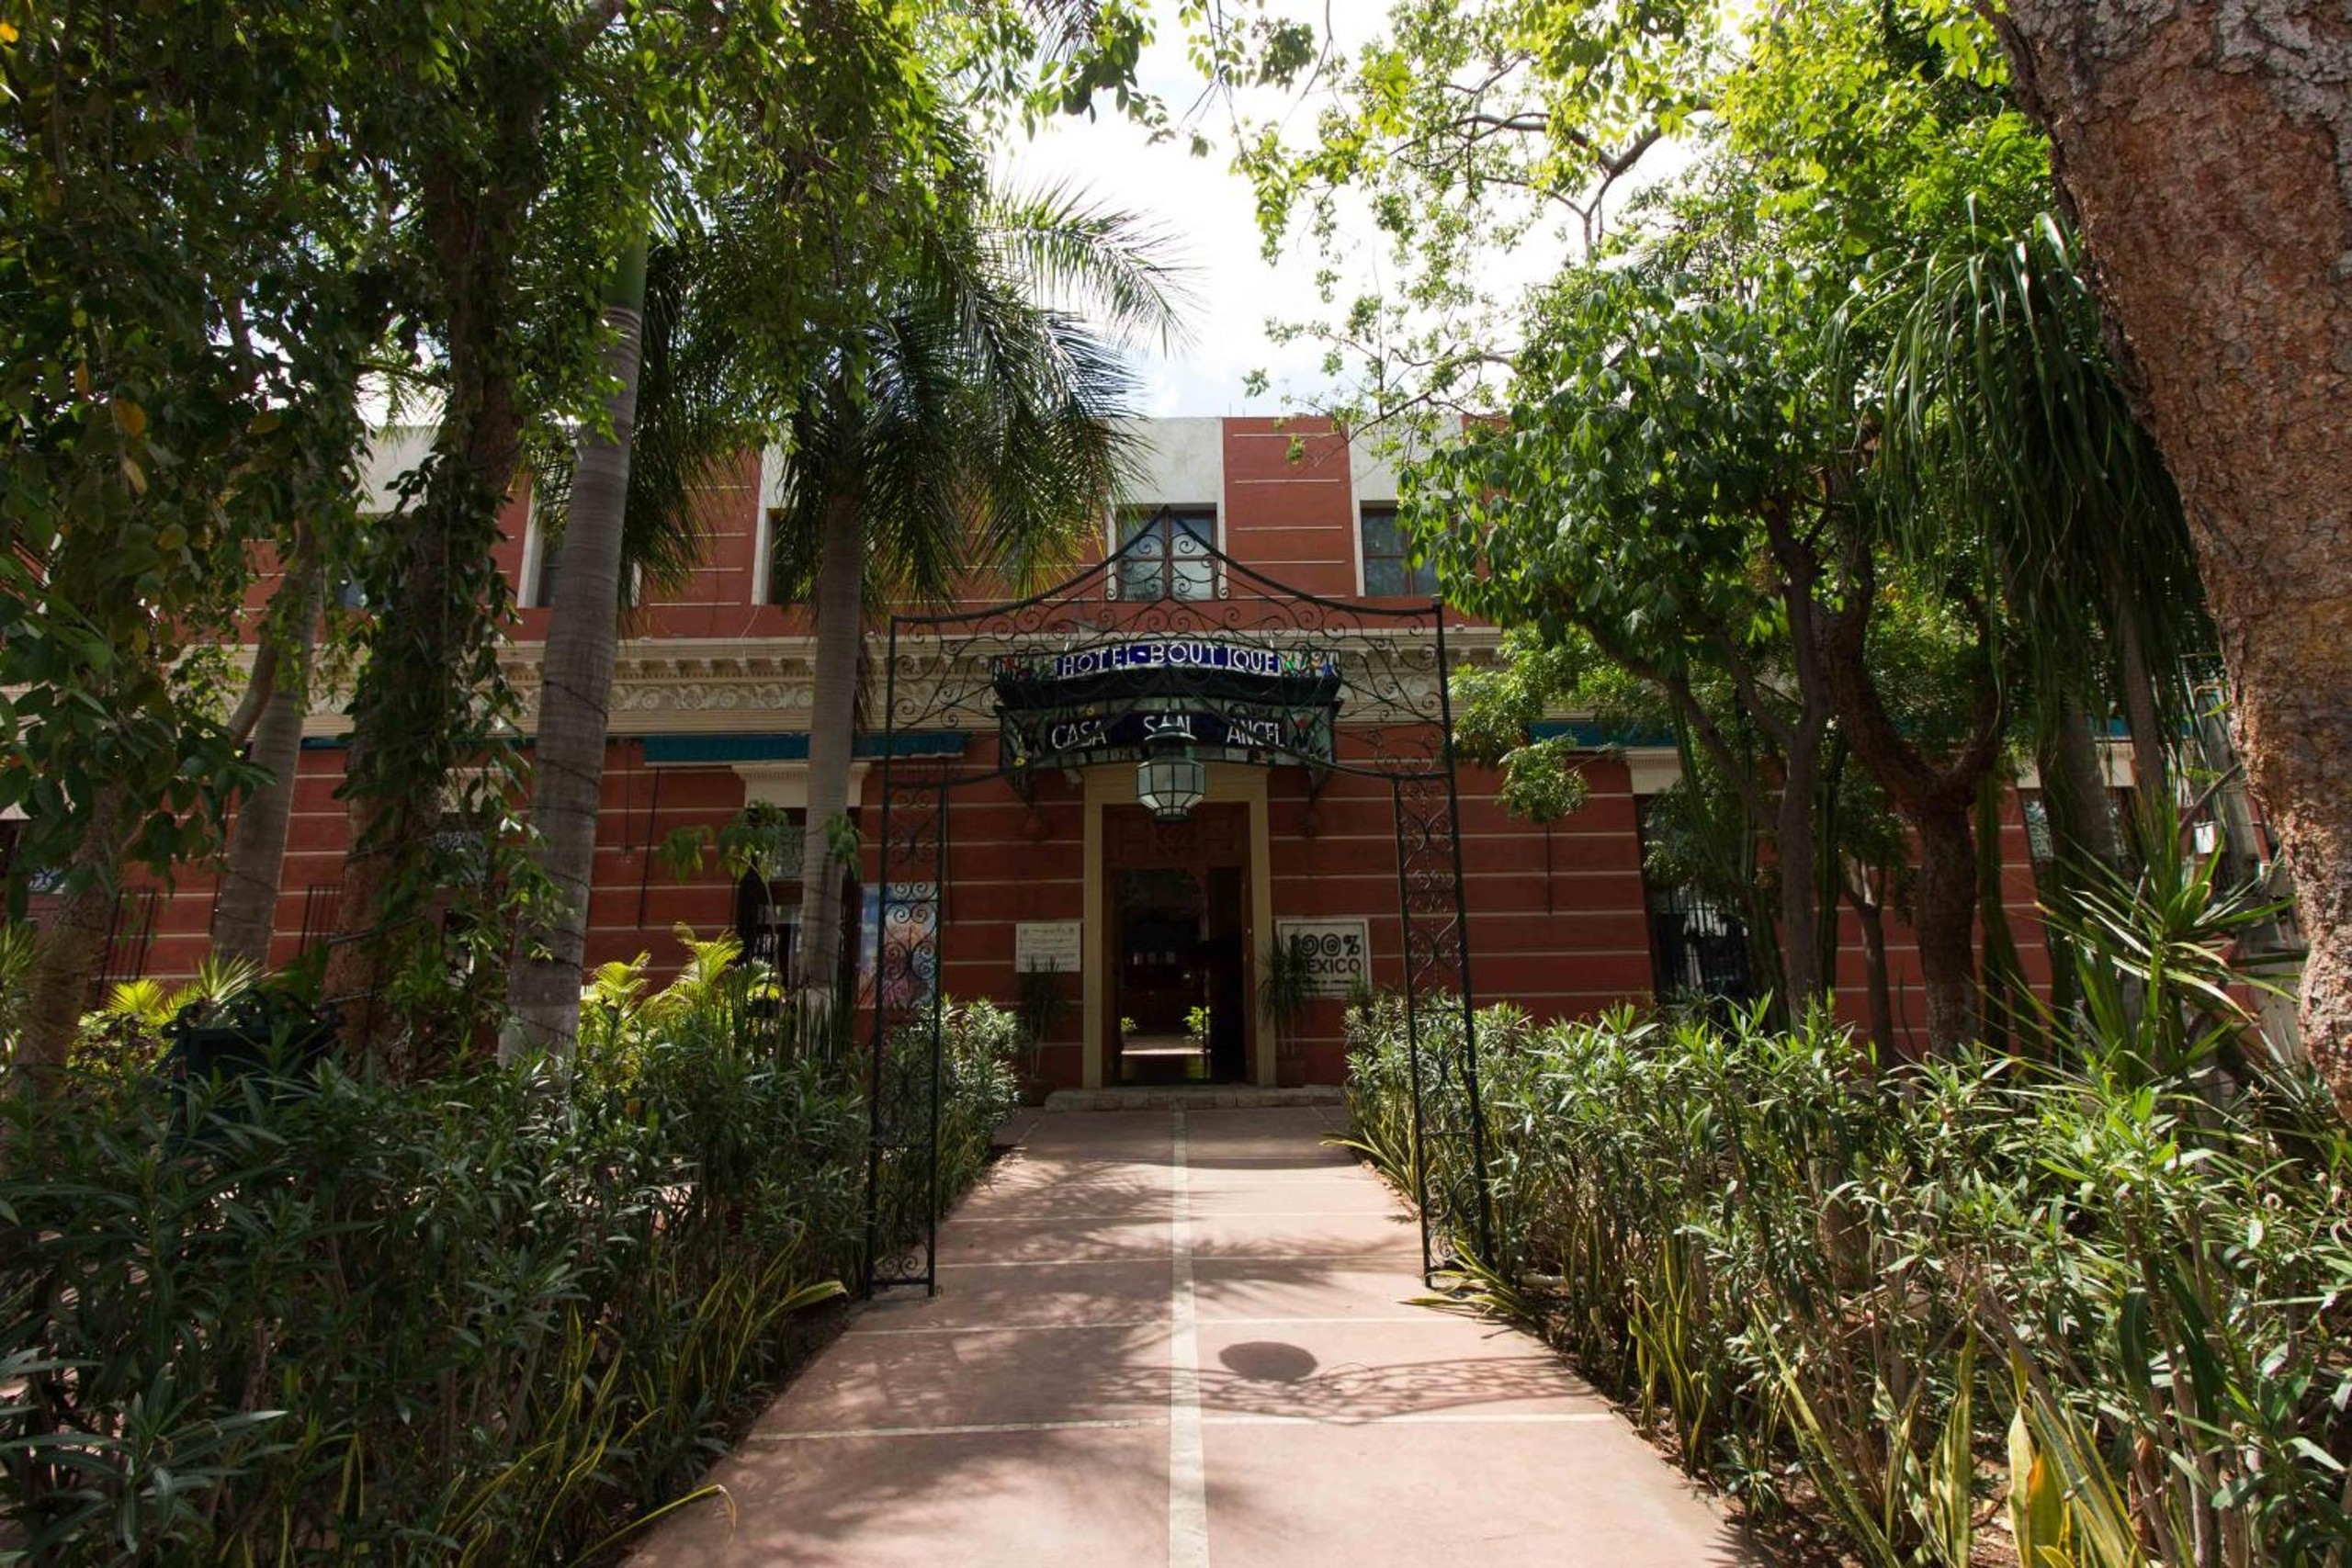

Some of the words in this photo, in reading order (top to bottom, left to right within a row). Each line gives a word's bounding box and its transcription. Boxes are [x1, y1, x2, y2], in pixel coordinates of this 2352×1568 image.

[1051, 720, 1107, 750] CASA
[1143, 715, 1192, 736] SN
[1290, 933, 1361, 956] 100%
[1294, 958, 1361, 974] EXICO
